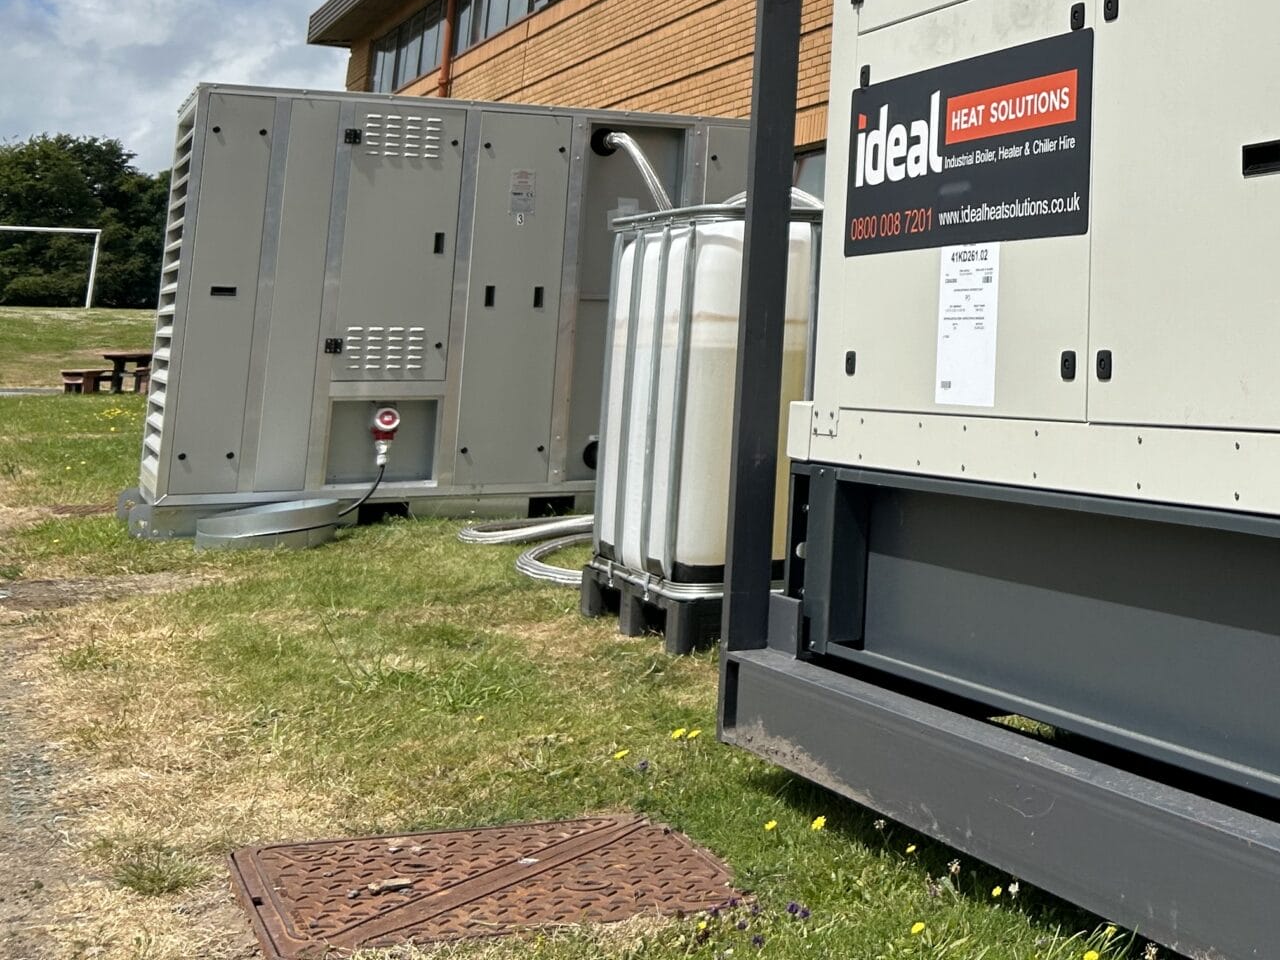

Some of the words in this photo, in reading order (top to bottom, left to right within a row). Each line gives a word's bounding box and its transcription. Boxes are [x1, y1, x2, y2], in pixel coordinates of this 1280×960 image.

[951, 105, 985, 132] HEAT
[990, 87, 1070, 124] SOLUTIONS
[855, 90, 942, 188] ideal
[944, 151, 974, 169] Industrial
[975, 149, 997, 163] Boiler,
[998, 145, 1023, 160] Heater
[1024, 141, 1030, 156] &
[1033, 138, 1057, 155] Chiller
[1059, 135, 1076, 151] Hire
[851, 215, 877, 240] 0800
[880, 212, 901, 237] 008
[904, 207, 932, 233] 7201
[938, 191, 1081, 226] www.idealheatsolutions.co.uk
